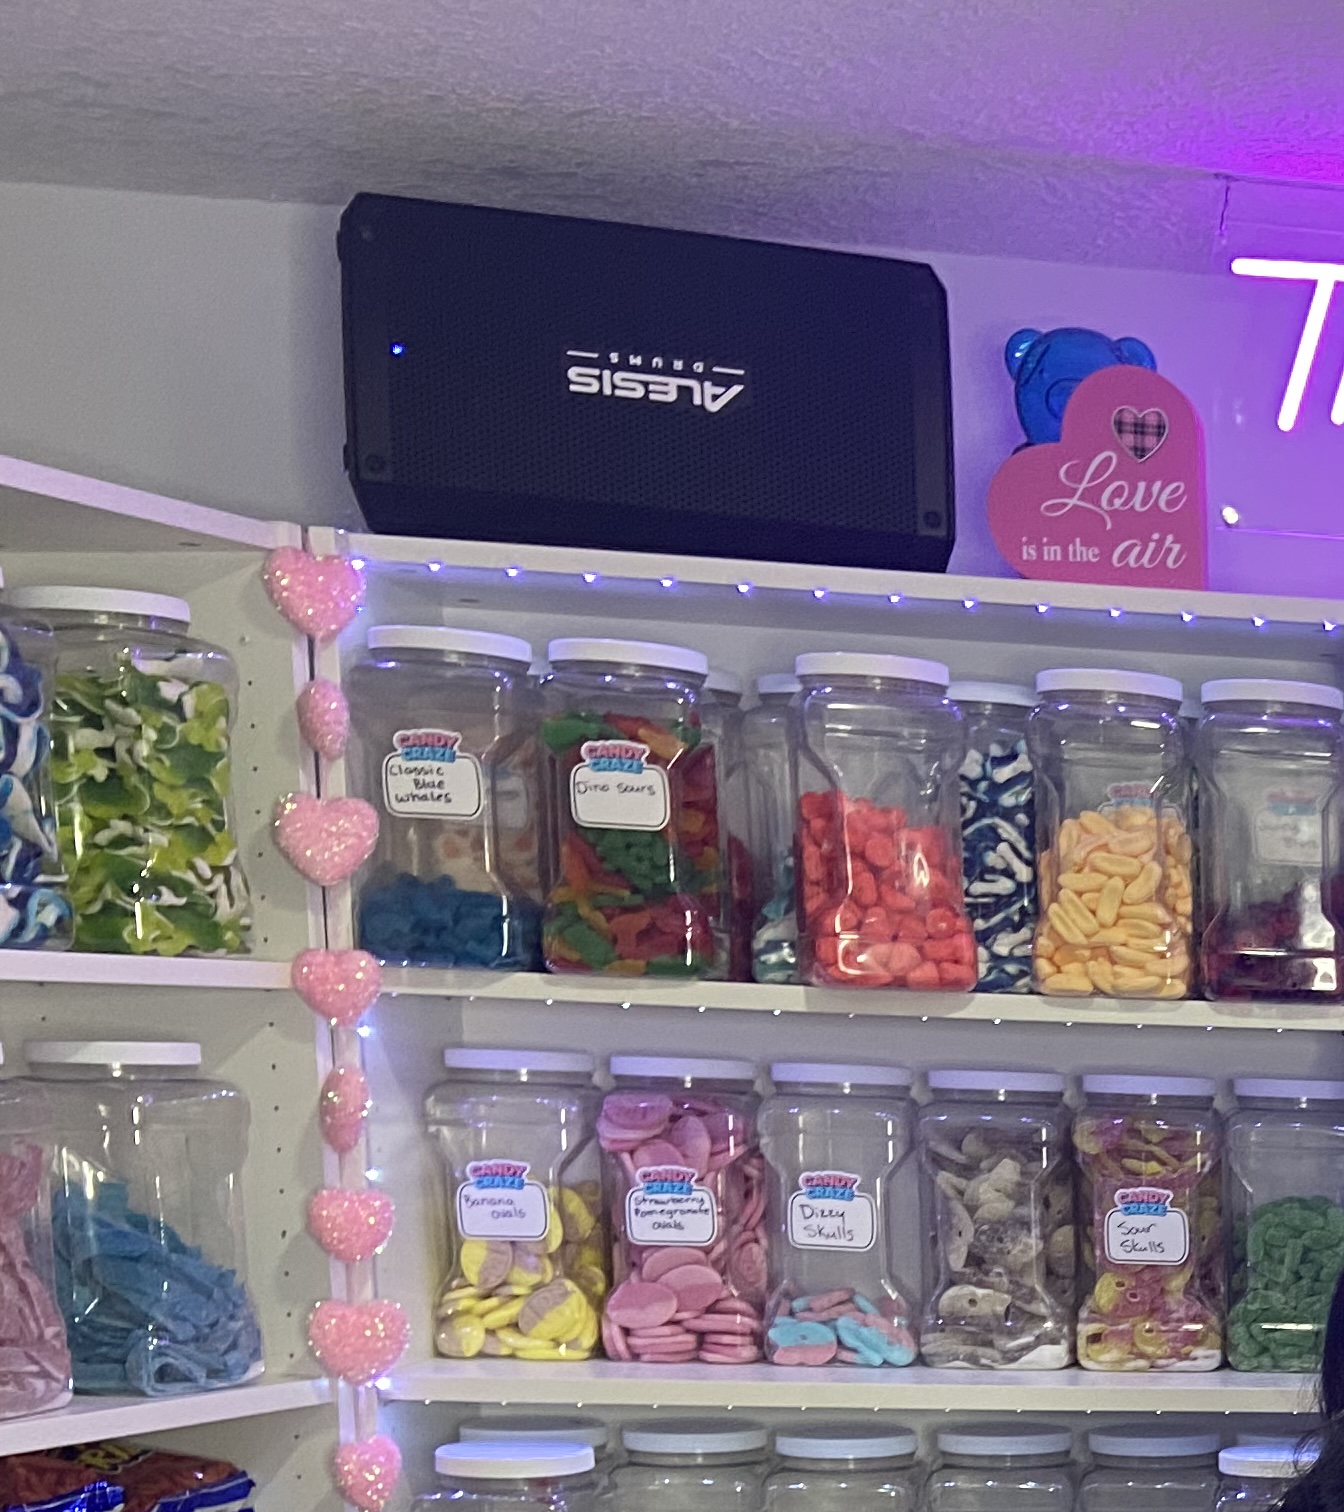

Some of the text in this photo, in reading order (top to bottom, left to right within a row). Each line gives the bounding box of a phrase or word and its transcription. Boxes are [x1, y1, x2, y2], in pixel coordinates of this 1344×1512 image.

[608, 352, 704, 374] DRUMS
[567, 366, 745, 412] ALESIS
[1041, 451, 1188, 530] Love
[1021, 534, 1187, 571] is in the air
